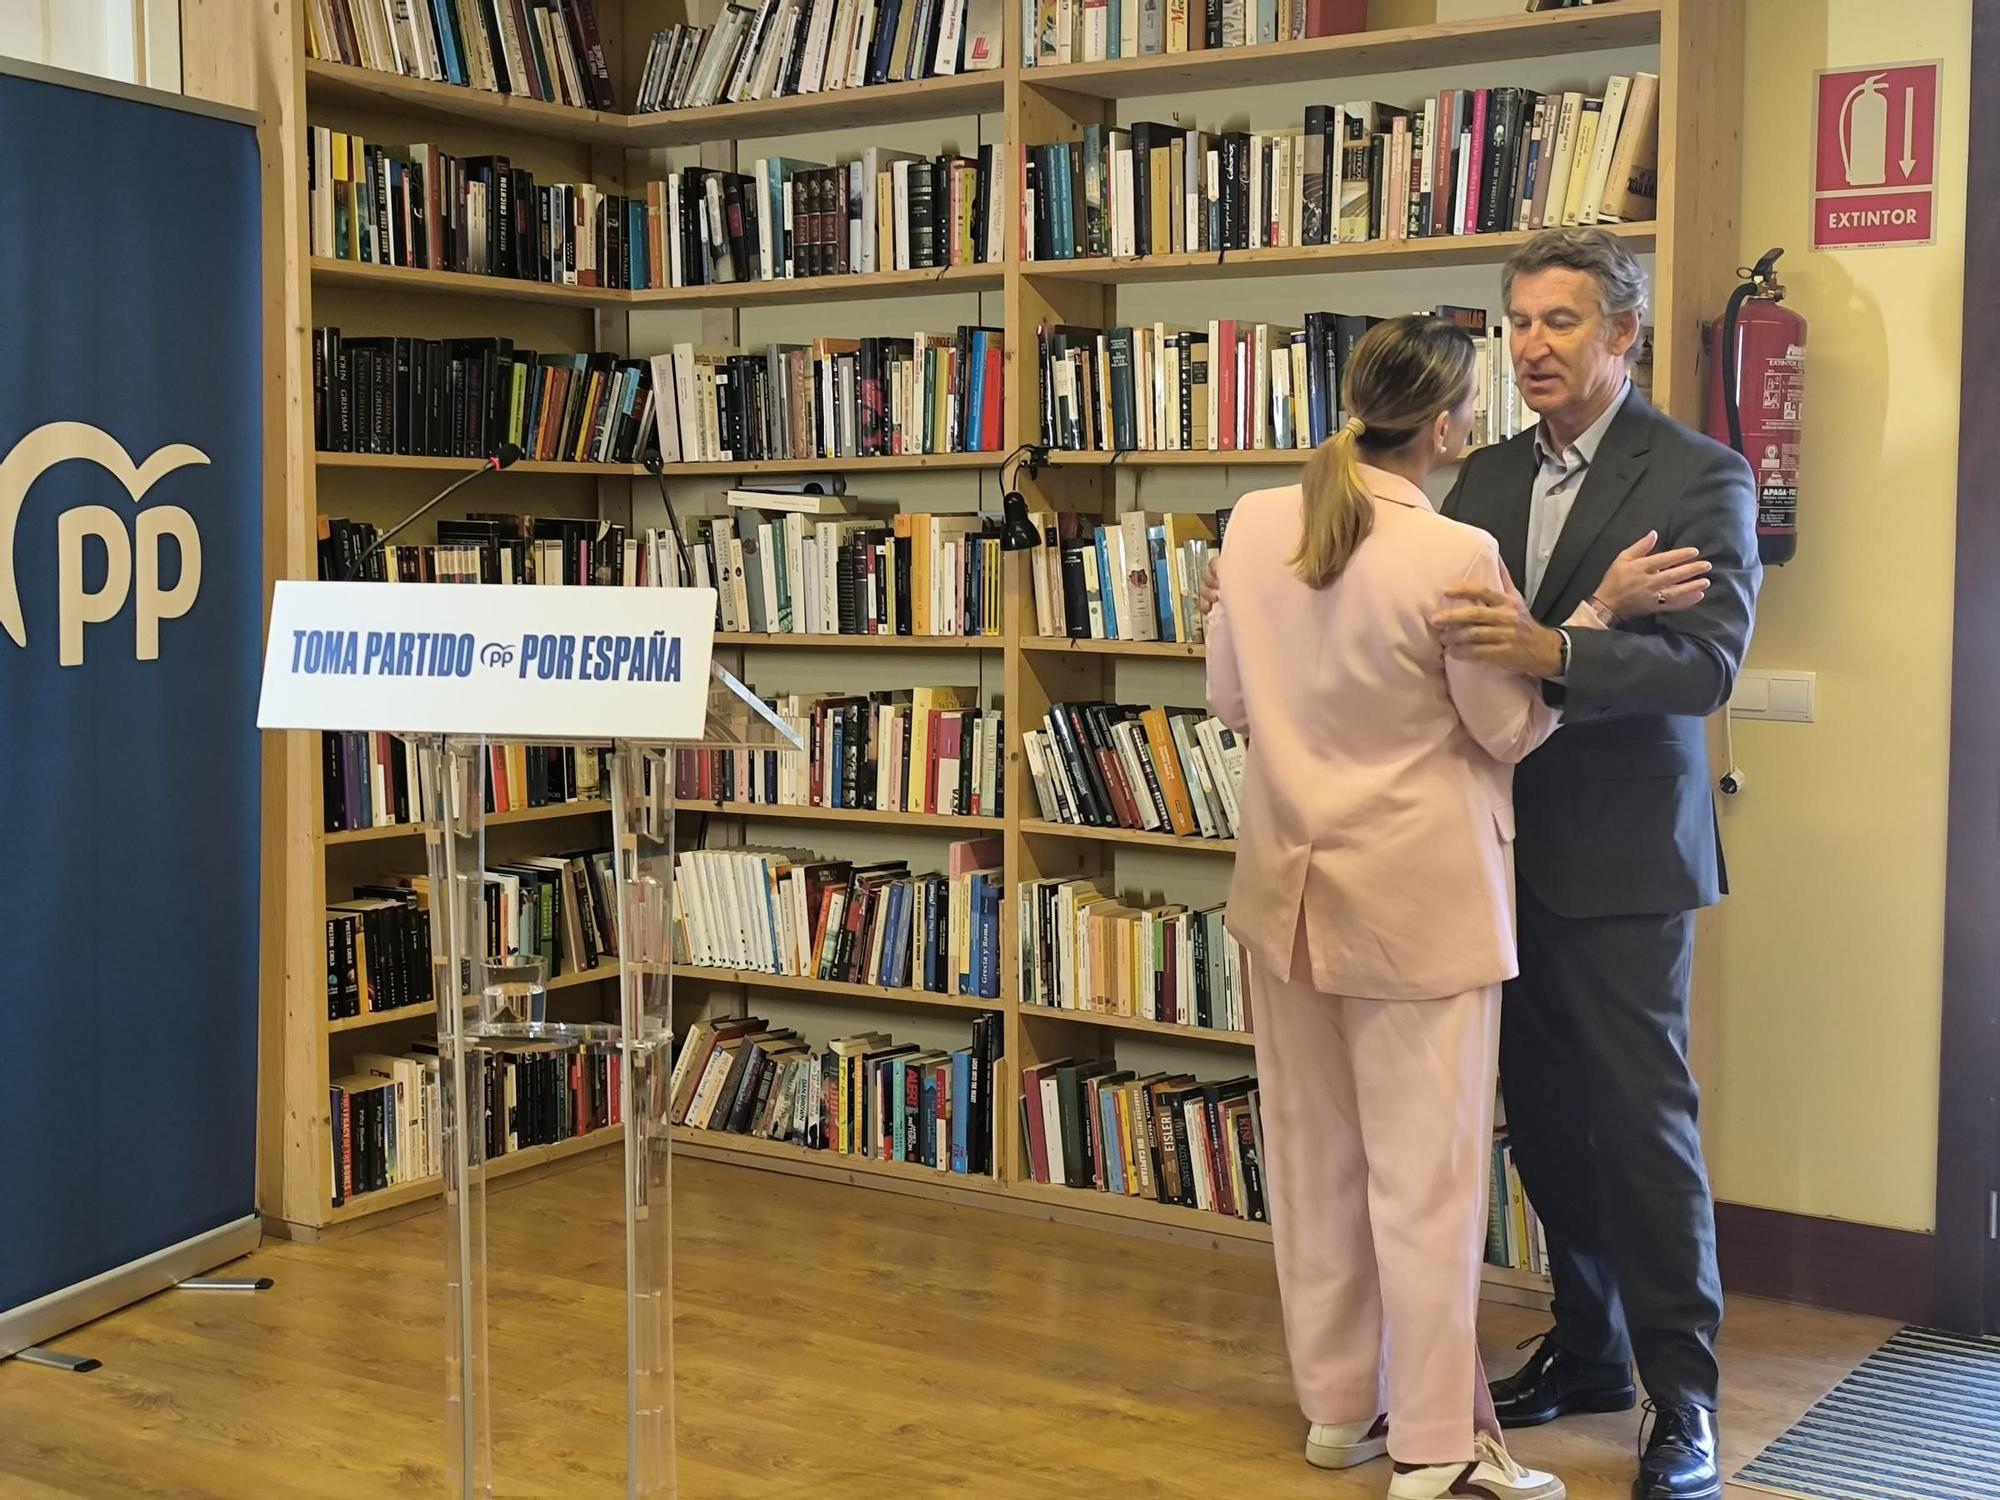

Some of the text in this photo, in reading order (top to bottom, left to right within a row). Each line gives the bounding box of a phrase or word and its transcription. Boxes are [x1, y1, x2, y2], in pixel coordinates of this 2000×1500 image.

[947, 18, 956, 40] Bernard
[1829, 208, 1917, 229] EXTINTOR
[292, 629, 358, 675] TOMA
[363, 631, 474, 678] PARTIDO
[519, 634, 572, 680] POR
[578, 630, 682, 683] ESPAÑA
[798, 1079, 808, 1122] DAN BROWN
[906, 1069, 918, 1105] ALERT
[1208, 1103, 1216, 1123] GLENN
[1147, 1121, 1155, 1148] TREATISE
[1162, 1117, 1175, 1152] EISLER
[1239, 1118, 1253, 1145] KING
[343, 1165, 351, 1190] BONES
[1138, 1138, 1148, 1186] UN CAPITANO
[1179, 1144, 1191, 1187] ACCELERANDO
